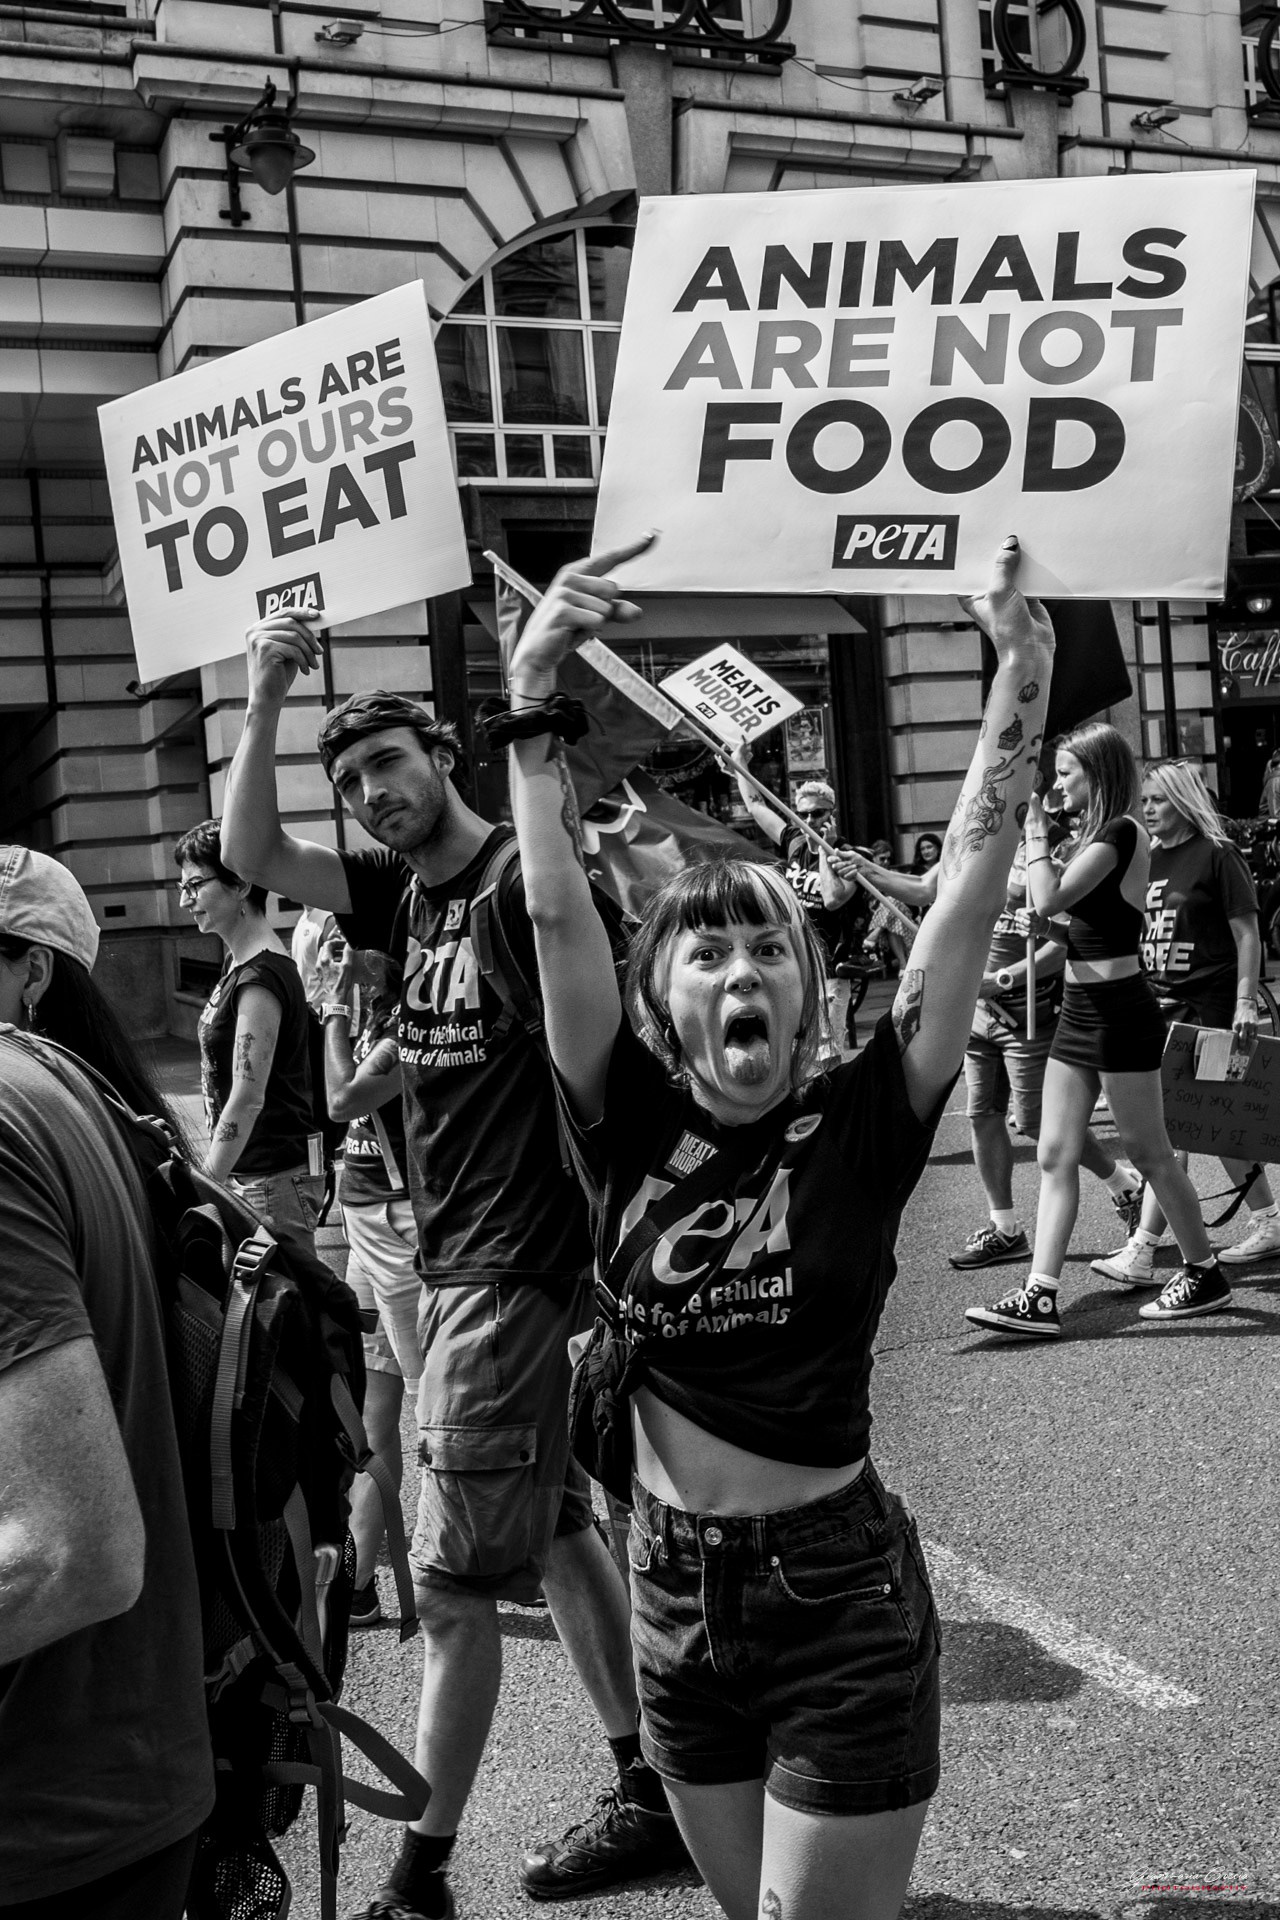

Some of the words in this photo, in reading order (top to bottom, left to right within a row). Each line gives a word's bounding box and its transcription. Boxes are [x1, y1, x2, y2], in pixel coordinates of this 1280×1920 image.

[672, 227, 1188, 313] ANIMALS
[662, 316, 896, 390] ARE
[929, 308, 1184, 387] NOT
[132, 376, 306, 473] ANIMALS
[318, 337, 405, 405] ARE
[135, 444, 240, 525] NOT
[257, 385, 414, 479] OURS
[696, 396, 1126, 494] FOOD
[144, 505, 249, 593] TO
[262, 440, 416, 558] EAT
[1217, 630, 1280, 686] Caff
[686, 668, 762, 733] MURDER
[709, 659, 764, 699] MEAT
[752, 695, 781, 716] IS
[407, 1021, 427, 1043] for
[421, 1049, 438, 1066] of
[435, 1043, 487, 1067] Animals
[1176, 1088, 1204, 1109] KIDS
[1242, 1101, 1269, 1121] TAKE
[680, 1133, 711, 1160] MEAT
[1211, 1125, 1222, 1142] A
[710, 1267, 794, 1310] Ethical
[661, 1319, 690, 1338] of
[696, 1303, 791, 1334] Animals
